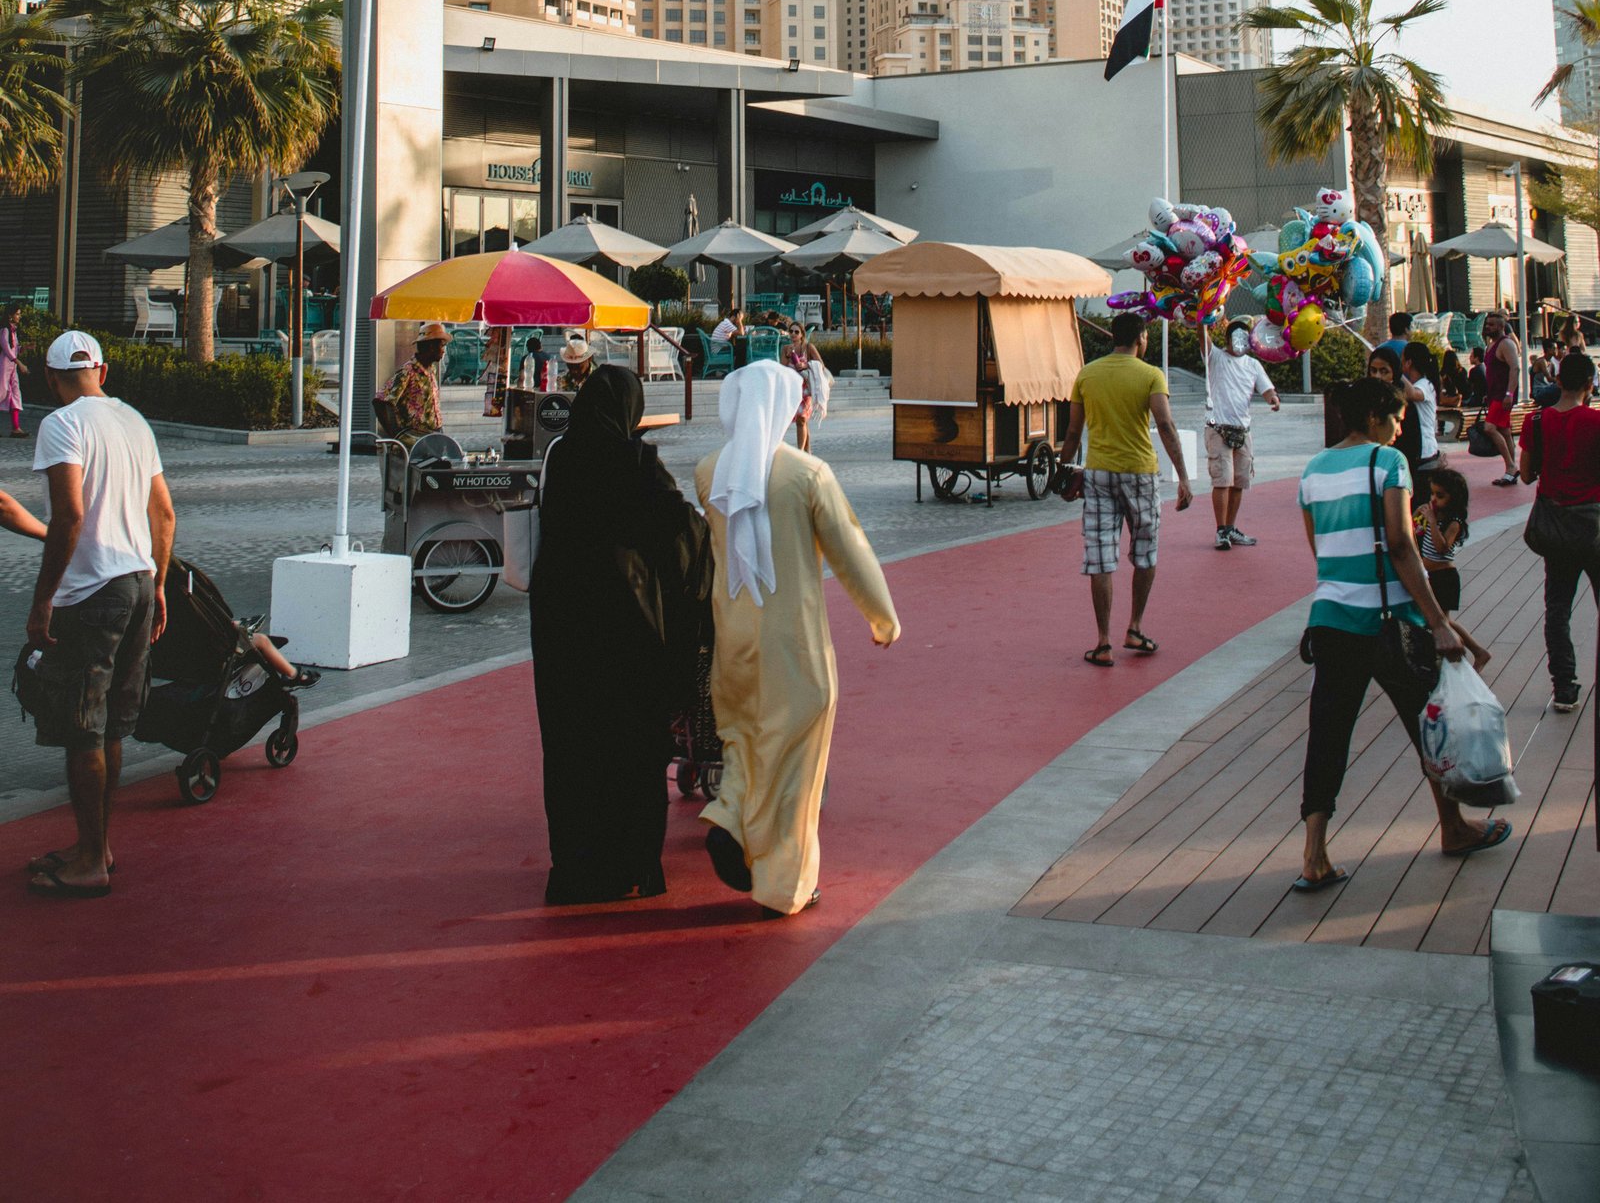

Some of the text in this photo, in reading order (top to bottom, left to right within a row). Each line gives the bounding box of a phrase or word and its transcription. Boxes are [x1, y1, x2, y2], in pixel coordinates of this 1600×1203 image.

[488, 163, 533, 181] HOUSE
[453, 477, 511, 486] NY HOT DOGS
